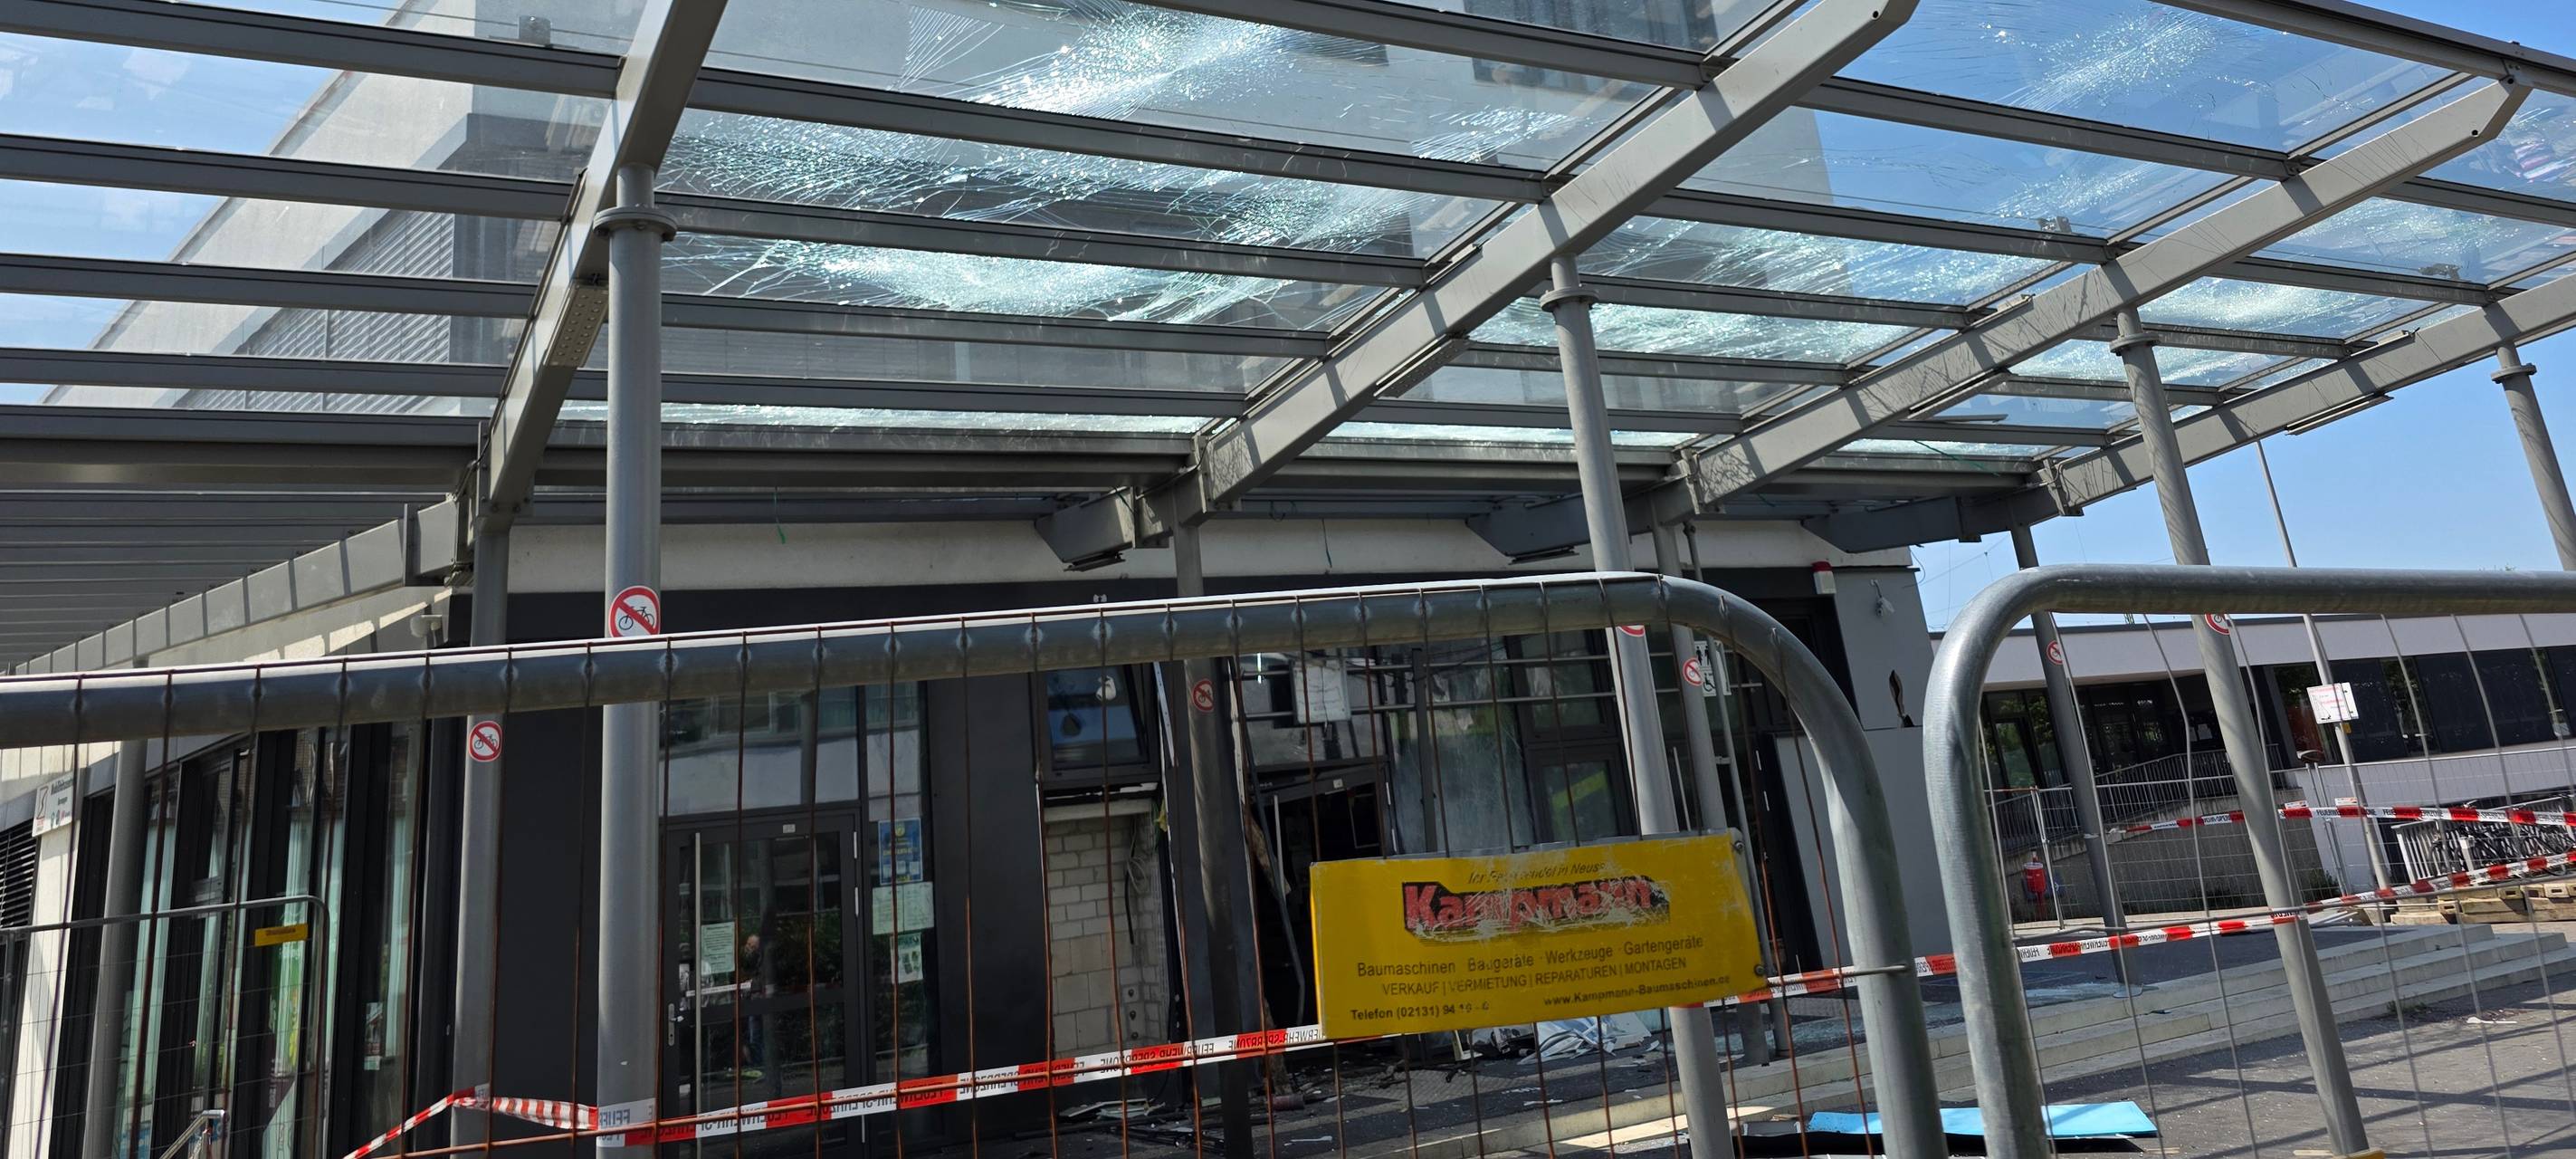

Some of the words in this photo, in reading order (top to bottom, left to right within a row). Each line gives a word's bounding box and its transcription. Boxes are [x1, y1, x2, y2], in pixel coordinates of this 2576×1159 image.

[1357, 961, 1455, 977] Baumaschinen
[1545, 946, 1613, 964] Werkzeuge
[1624, 935, 1703, 957] Gartengeräte
[1383, 981, 1439, 995] VERKAUF
[1448, 974, 1527, 992] VERMIETUNG
[1535, 963, 1617, 985] REPARATUREN
[1625, 957, 1687, 975] MONTAGEN
[1350, 1008, 1393, 1020] Telefon
[1397, 1005, 1439, 1020] (02131)
[1443, 1004, 1455, 1015] 94
